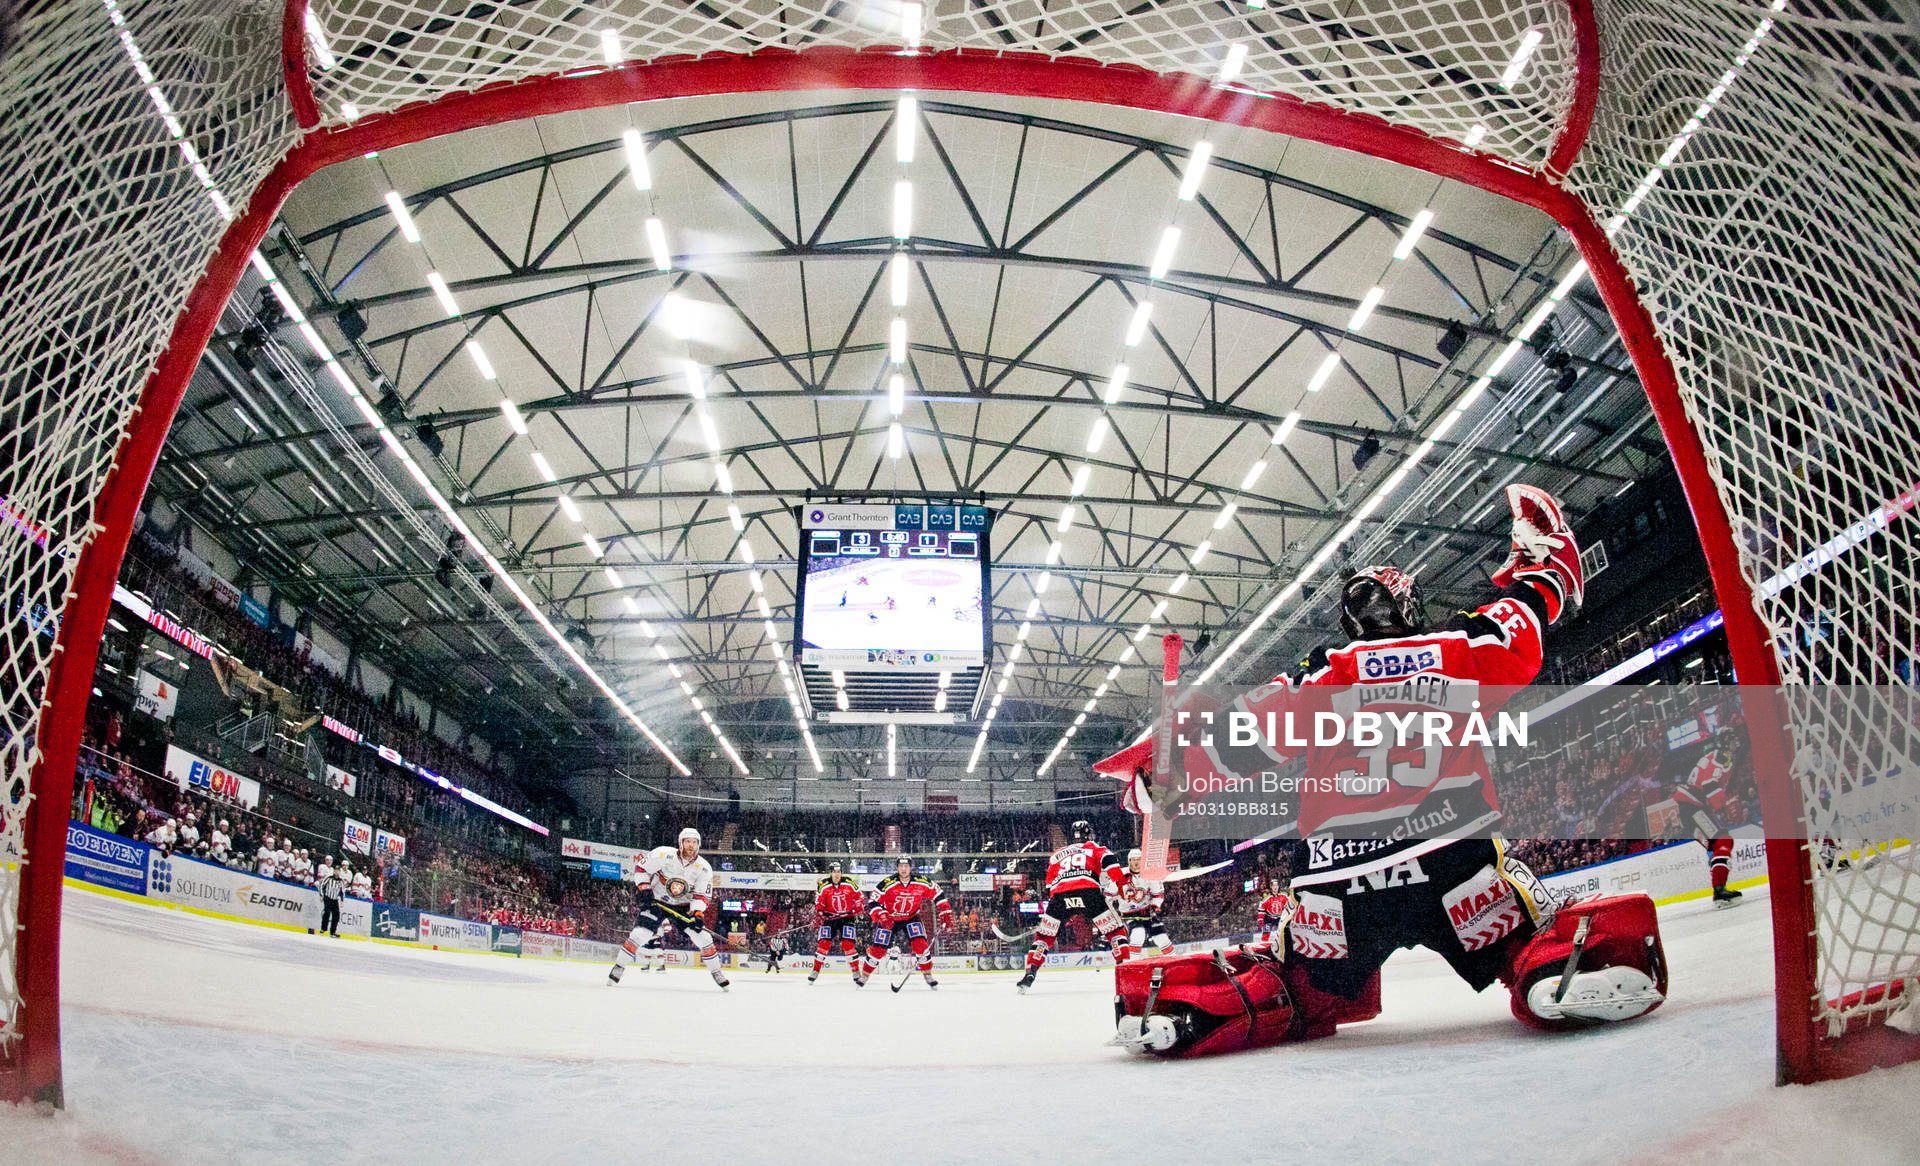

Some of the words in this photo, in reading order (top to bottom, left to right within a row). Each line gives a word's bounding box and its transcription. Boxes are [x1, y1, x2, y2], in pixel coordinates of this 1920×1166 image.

[827, 512, 851, 522] Grant
[851, 512, 889, 522] Thornton
[1364, 651, 1436, 678] ÖBAB
[189, 760, 241, 800] ELON
[347, 825, 369, 843] ELON
[1310, 799, 1458, 865] Katrinelund
[377, 834, 404, 855] ELON
[730, 876, 758, 885] Swegon
[1346, 857, 1429, 896] NA
[176, 878, 231, 904] SOLIDUM
[1548, 882, 1587, 900] Carlsson
[1588, 876, 1600, 892] Bil
[250, 892, 303, 913] EASTON
[1063, 896, 1086, 909] NA
[1449, 879, 1511, 927] MAXI
[431, 923, 461, 940] WÜRTH
